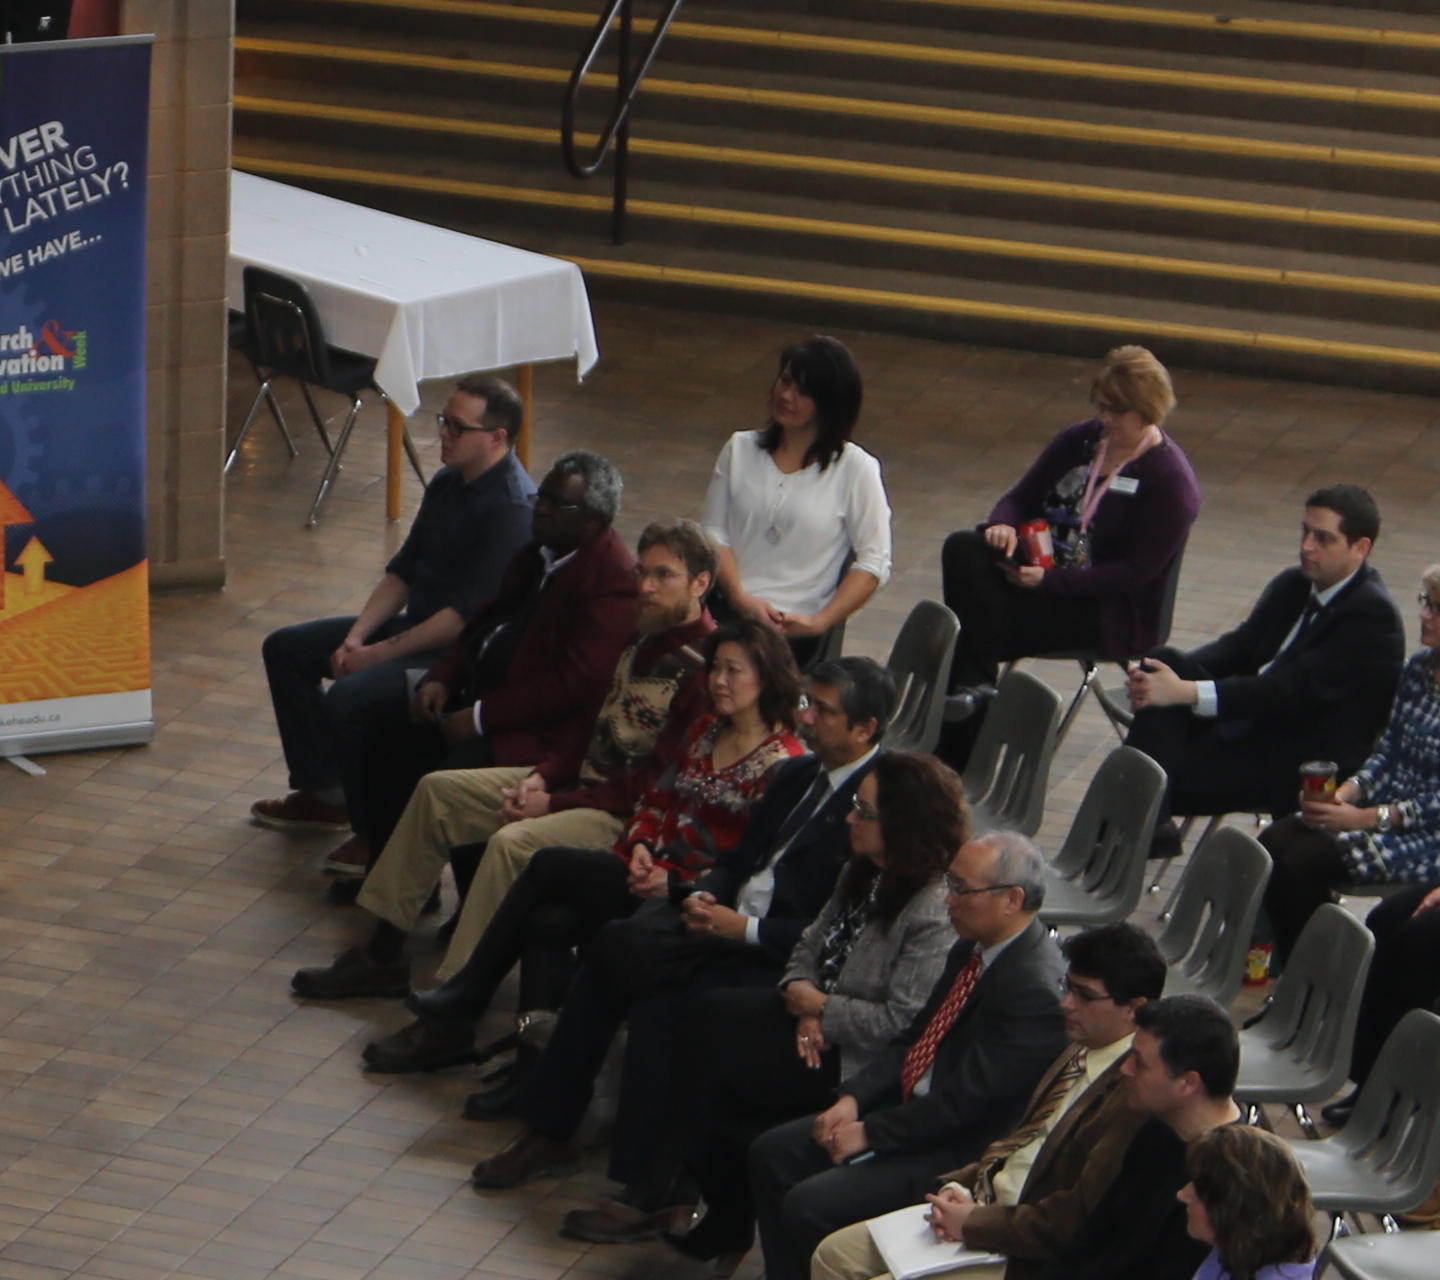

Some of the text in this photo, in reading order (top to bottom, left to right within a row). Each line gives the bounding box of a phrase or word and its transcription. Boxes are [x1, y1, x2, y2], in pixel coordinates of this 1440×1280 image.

[4, 161, 129, 233] LATELY?
[73, 330, 87, 369] Week
[11, 377, 76, 394] University
